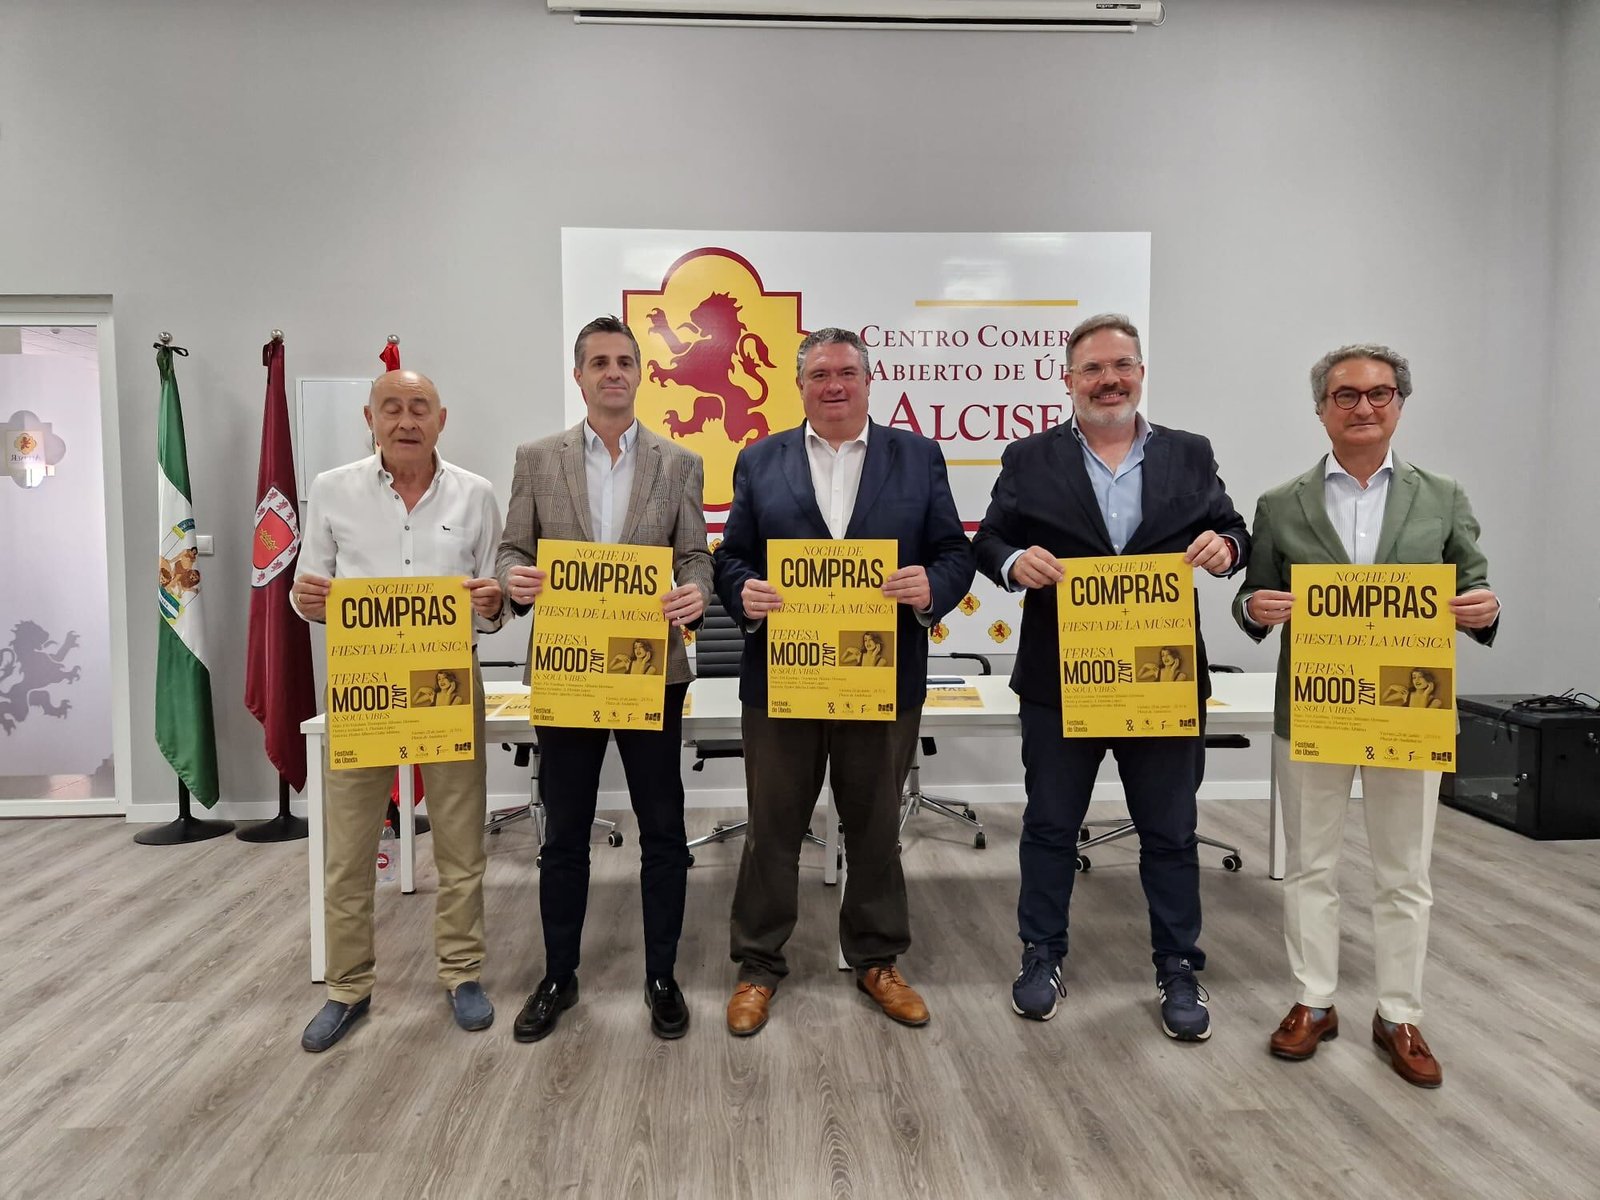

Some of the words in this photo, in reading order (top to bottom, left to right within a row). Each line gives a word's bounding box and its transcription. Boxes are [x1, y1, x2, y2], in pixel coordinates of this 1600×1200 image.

[860, 325, 969, 347] CENTRO
[871, 360, 982, 381] ABIERTO
[994, 364, 1025, 381] DE
[889, 391, 1068, 441] ALCISE
[575, 548, 620, 561] NOCHE
[621, 551, 639, 562] DE
[802, 546, 845, 557] NOCHE
[847, 546, 864, 556] DE
[550, 559, 658, 596] COMPRAS
[781, 558, 884, 588] COMPRAS
[1093, 562, 1137, 573] NOCHE
[1140, 561, 1156, 572] DE
[1335, 571, 1387, 583] NOCHE
[1390, 572, 1411, 583] DE
[366, 583, 413, 595] NOCHE
[416, 583, 434, 594] DE
[1071, 572, 1179, 606] COMPRAS
[342, 595, 457, 629] COMPRAS
[538, 605, 580, 618] FIESTA
[582, 608, 600, 619] DE
[601, 609, 617, 620] LA
[812, 603, 829, 614] DE
[831, 604, 846, 614] LA
[848, 602, 894, 614] MÚSICA
[1307, 584, 1437, 619] COMPRAS
[770, 629, 820, 640] TERESA
[1062, 620, 1104, 632] FIESTA
[1106, 620, 1123, 631] DE
[1125, 620, 1140, 630] LA
[1143, 617, 1192, 629] MÚSICA
[331, 643, 377, 657] FIESTA
[380, 643, 398, 655] DE
[400, 642, 417, 654] LA
[420, 640, 469, 653] MÚSICA
[537, 632, 588, 646] TERESA
[1295, 633, 1343, 646] FIESTA
[1347, 635, 1367, 646] DE
[1370, 635, 1388, 647] LA
[1391, 634, 1452, 649] MÚSICA
[535, 645, 588, 672] MOOD
[589, 649, 605, 674] JAZZ
[770, 642, 820, 666] MOOD
[822, 642, 836, 667] JAZZ
[1063, 647, 1114, 659] TERESA
[331, 672, 389, 686] TERESA
[1064, 660, 1115, 684] MOOD
[1117, 659, 1132, 683] JAZZ
[1294, 662, 1355, 675] TERESA
[332, 685, 389, 713] MOOD
[391, 684, 407, 709] JAZZ
[1294, 675, 1355, 704] MOOD
[1358, 678, 1375, 706] JAZZ
